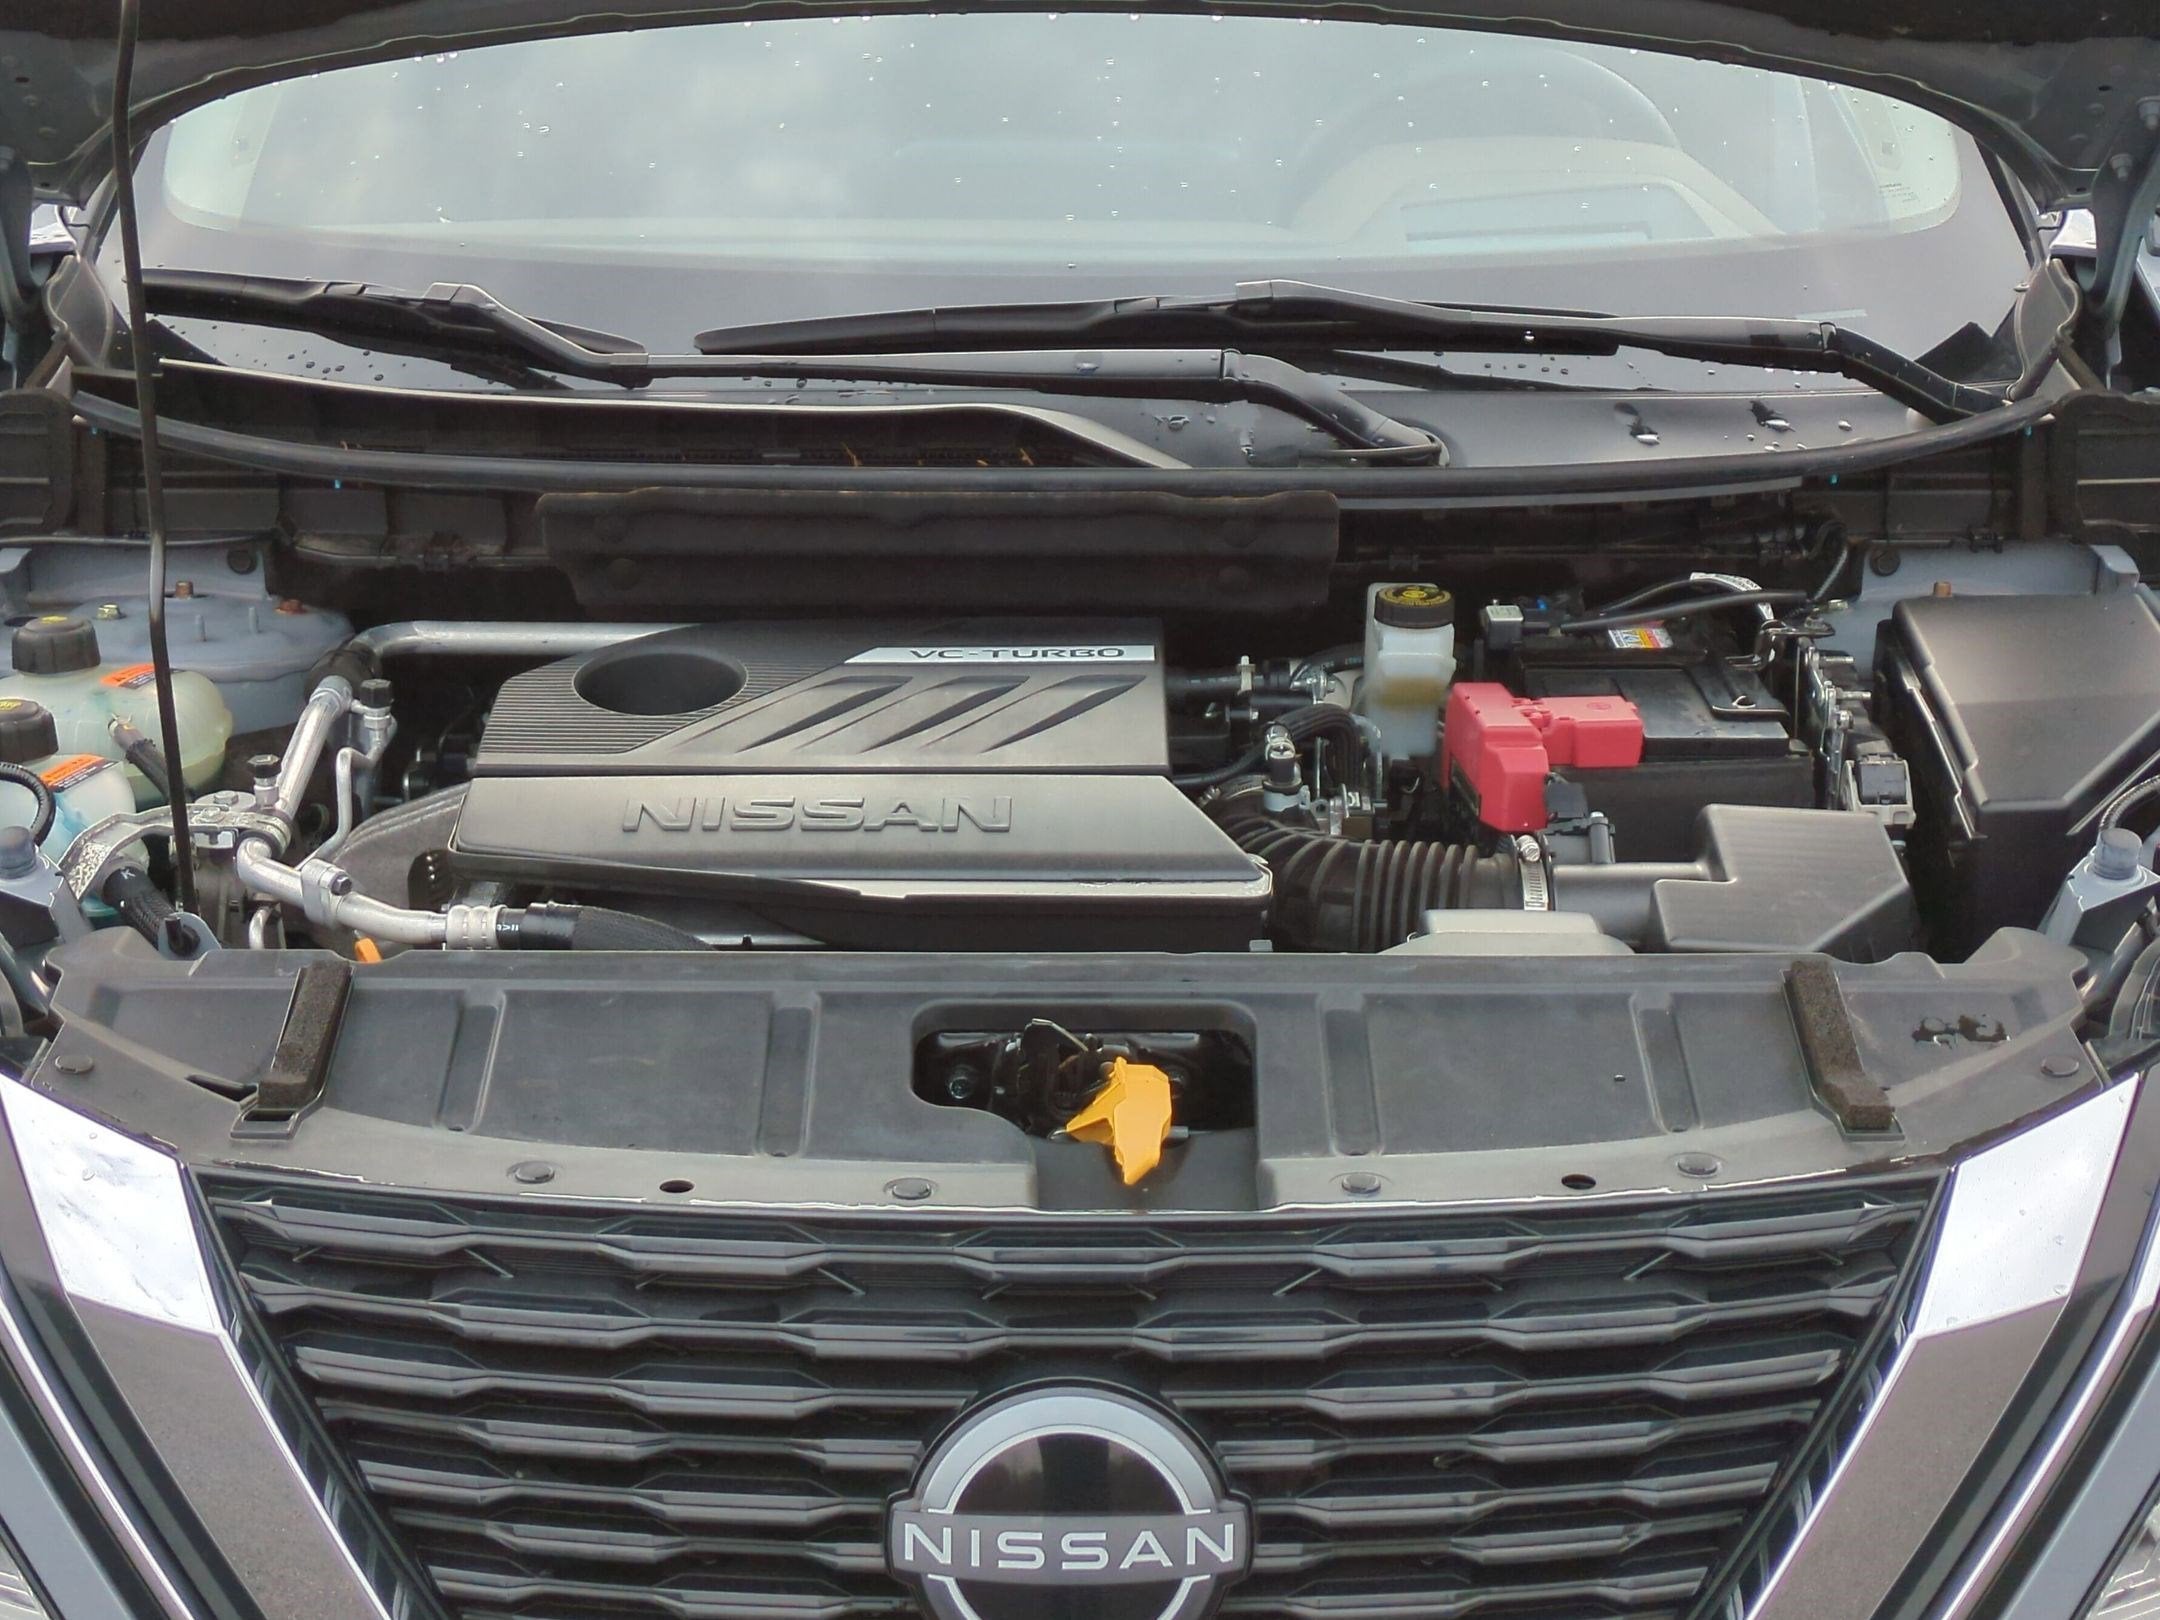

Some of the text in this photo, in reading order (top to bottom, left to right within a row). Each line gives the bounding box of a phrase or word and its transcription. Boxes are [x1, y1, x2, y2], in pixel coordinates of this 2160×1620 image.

[910, 648, 1125, 659] VC-TURBO
[622, 795, 1013, 833] NISSAN
[904, 1522, 1234, 1570] NISSAN
